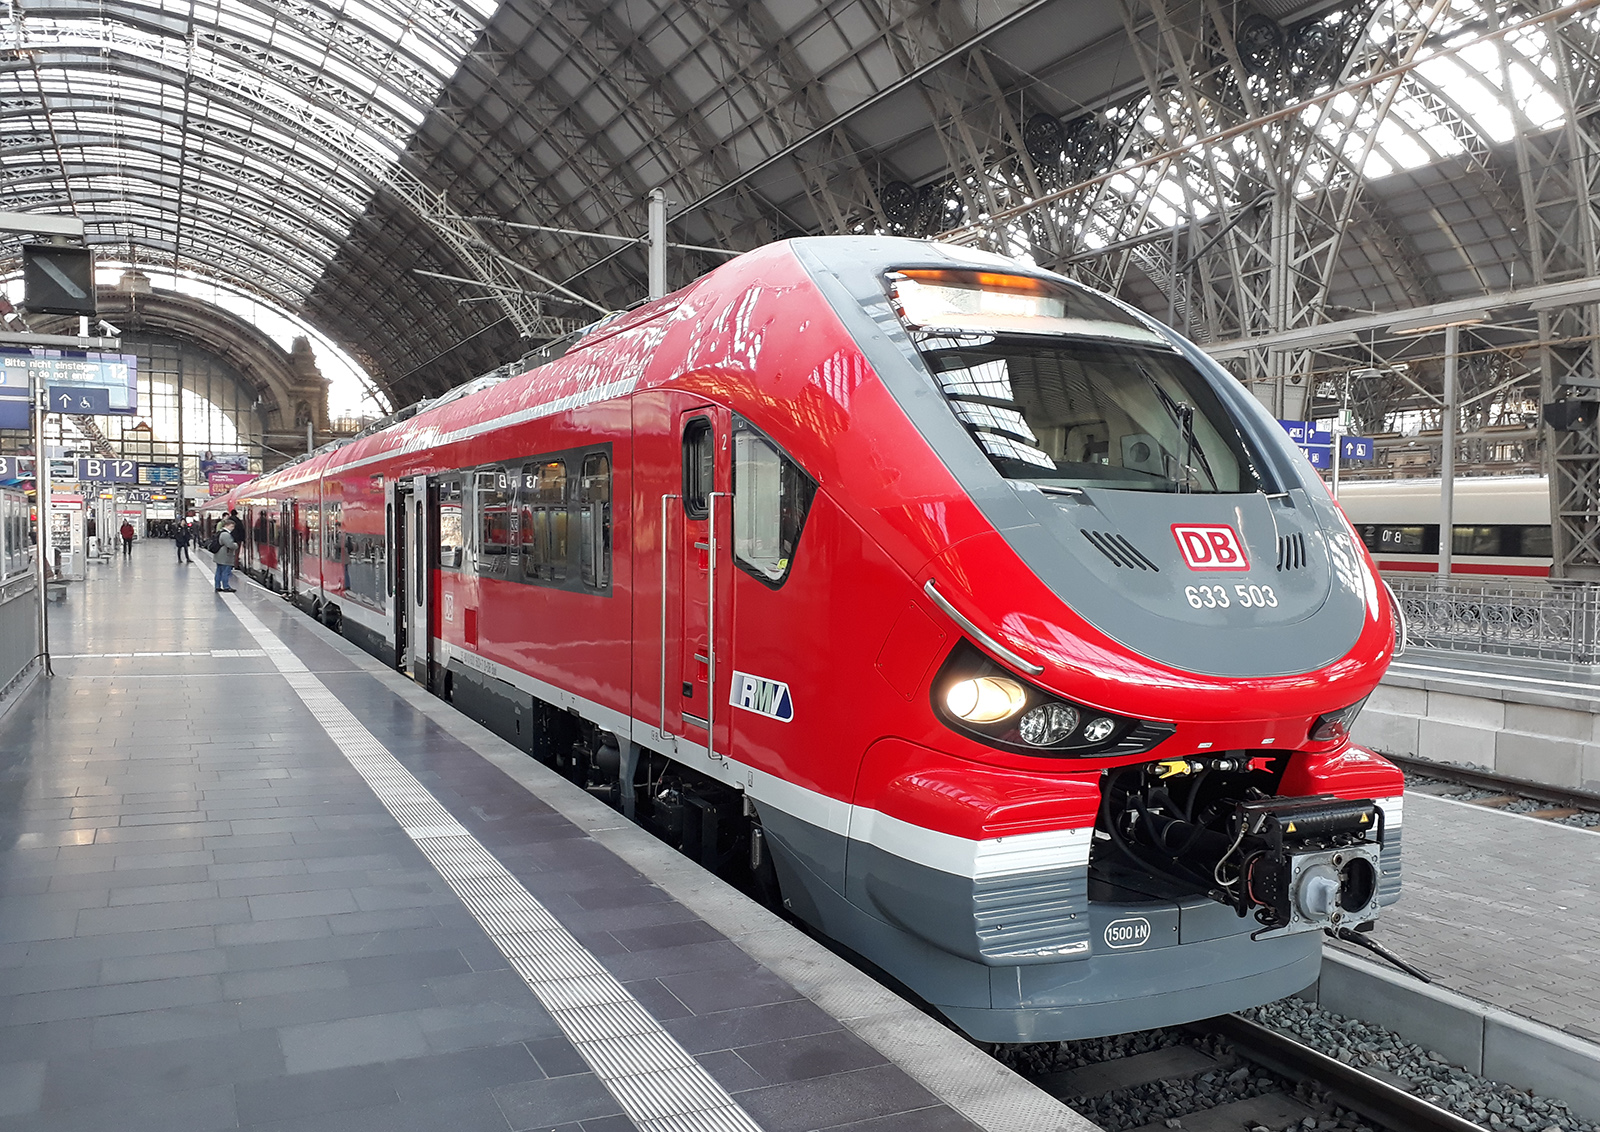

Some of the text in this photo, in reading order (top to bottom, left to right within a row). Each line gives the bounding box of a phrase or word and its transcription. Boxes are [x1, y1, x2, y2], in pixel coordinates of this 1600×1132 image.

[4, 358, 26, 368] Bitte
[30, 359, 52, 369] nicht
[108, 363, 128, 379] 12
[38, 369, 50, 378] do
[53, 371, 68, 379] not
[71, 372, 96, 381] enter
[721, 433, 727, 451] 2
[87, 460, 101, 476] B
[112, 460, 134, 478] 12
[140, 492, 151, 501] 12
[1181, 531, 1238, 563] DB
[1184, 584, 1279, 609] 633 503
[740, 676, 786, 716] RMV
[1108, 924, 1147, 941] 1500 kN
